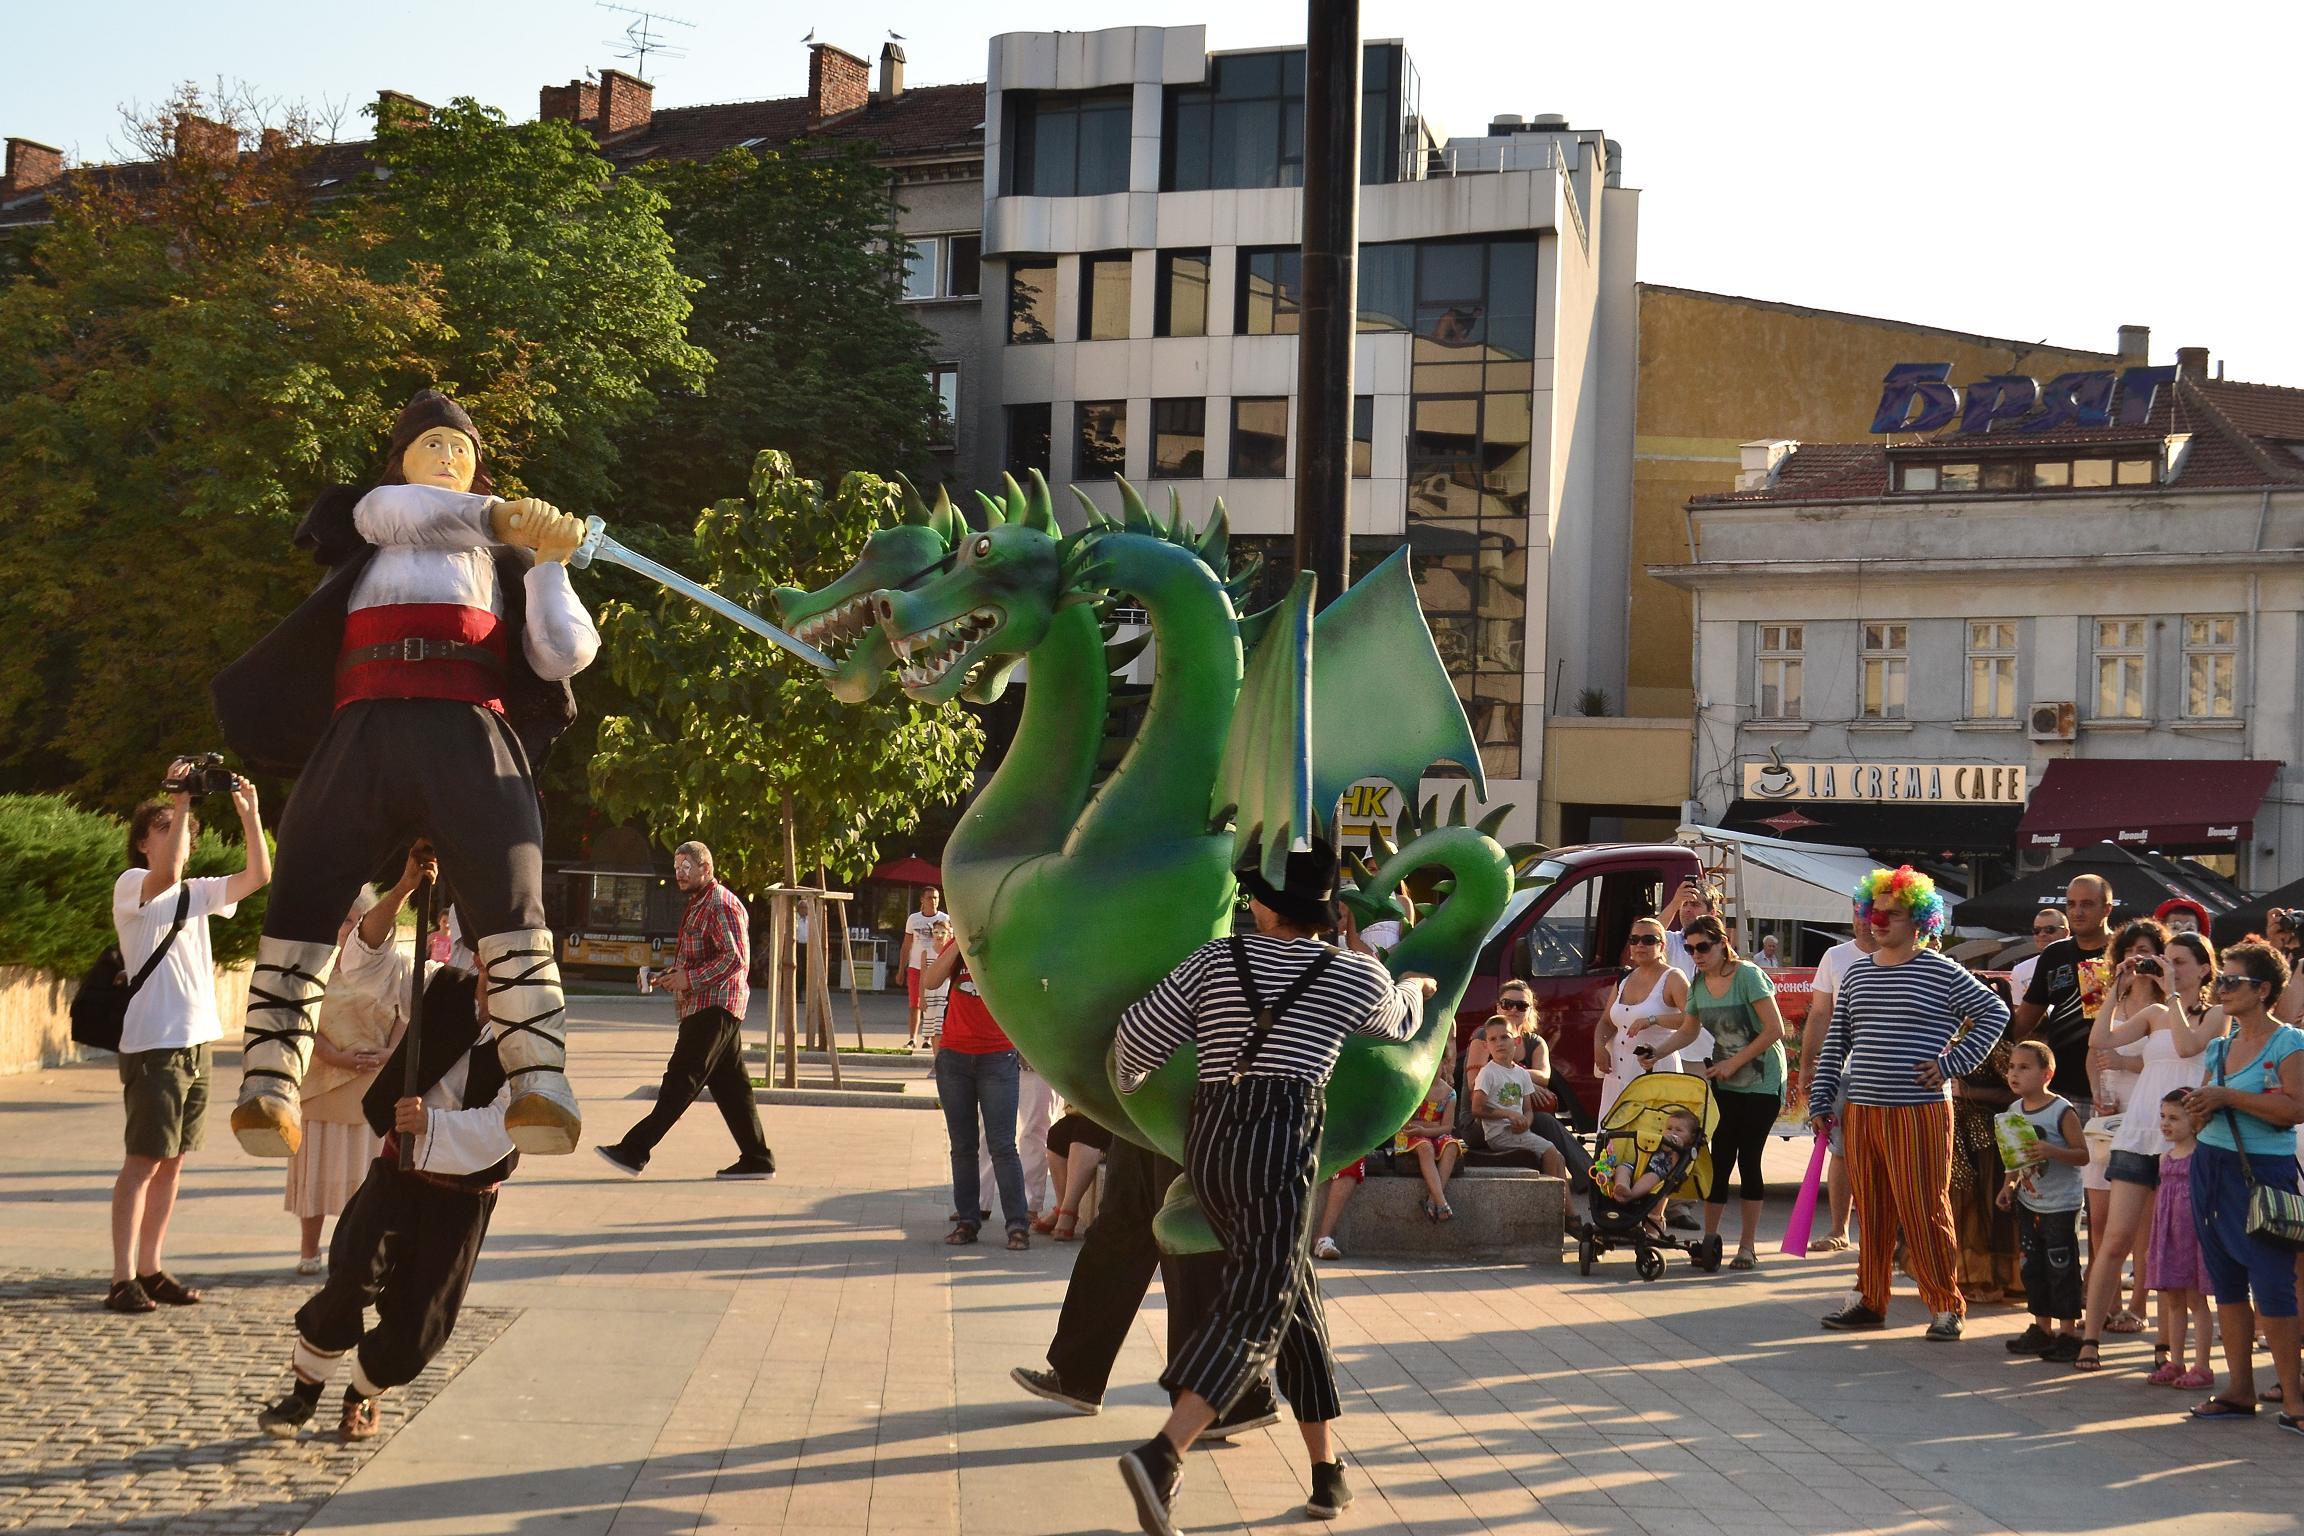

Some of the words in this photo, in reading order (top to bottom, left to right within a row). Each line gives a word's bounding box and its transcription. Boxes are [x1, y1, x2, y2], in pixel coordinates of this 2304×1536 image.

[1807, 766, 1836, 797] LA
[1851, 766, 1942, 799] CREMA
[1955, 767, 2019, 800] CAFE
